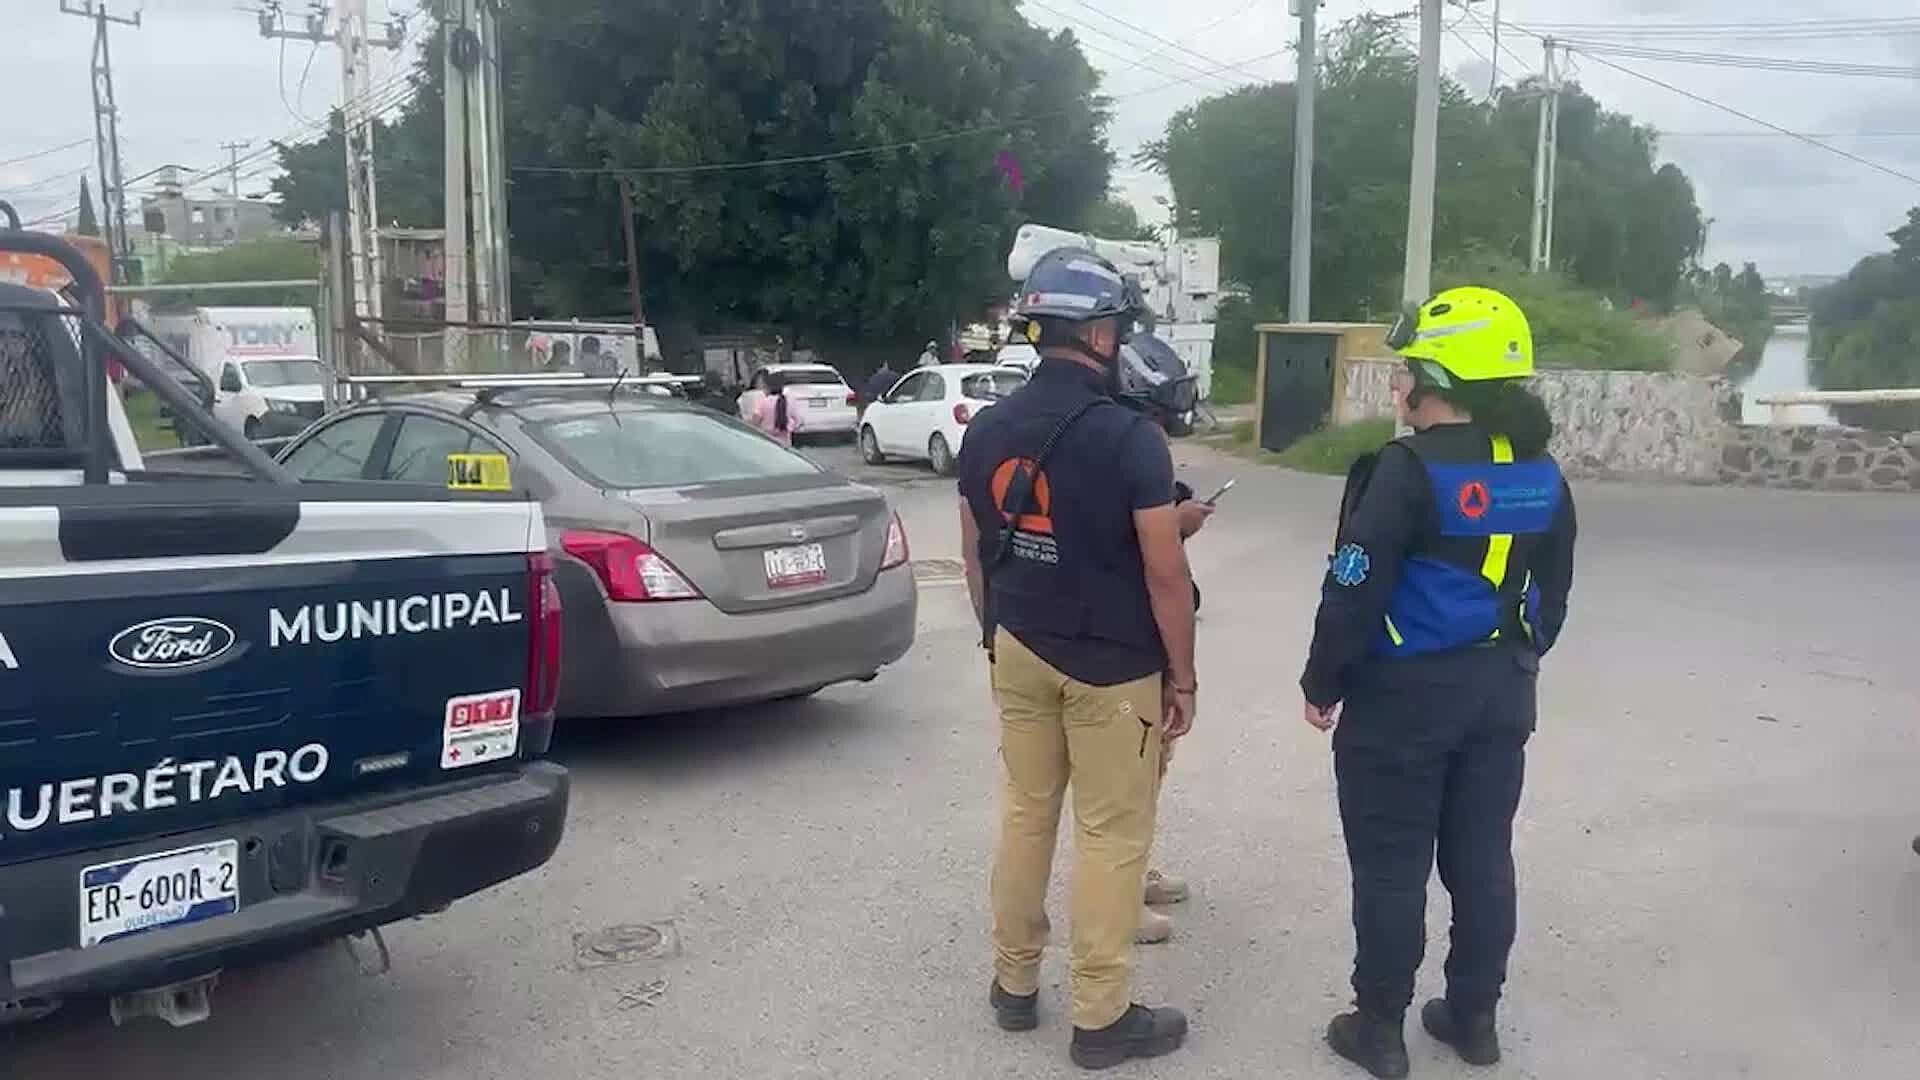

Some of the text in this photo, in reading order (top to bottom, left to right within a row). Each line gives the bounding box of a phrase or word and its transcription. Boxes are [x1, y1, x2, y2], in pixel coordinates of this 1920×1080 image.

[132, 624, 211, 661] Ford
[268, 588, 521, 647] MUNICIPAL
[455, 700, 512, 726] 911
[0, 743, 329, 840] UERÉTARO
[88, 862, 234, 923] ER-600A-2
